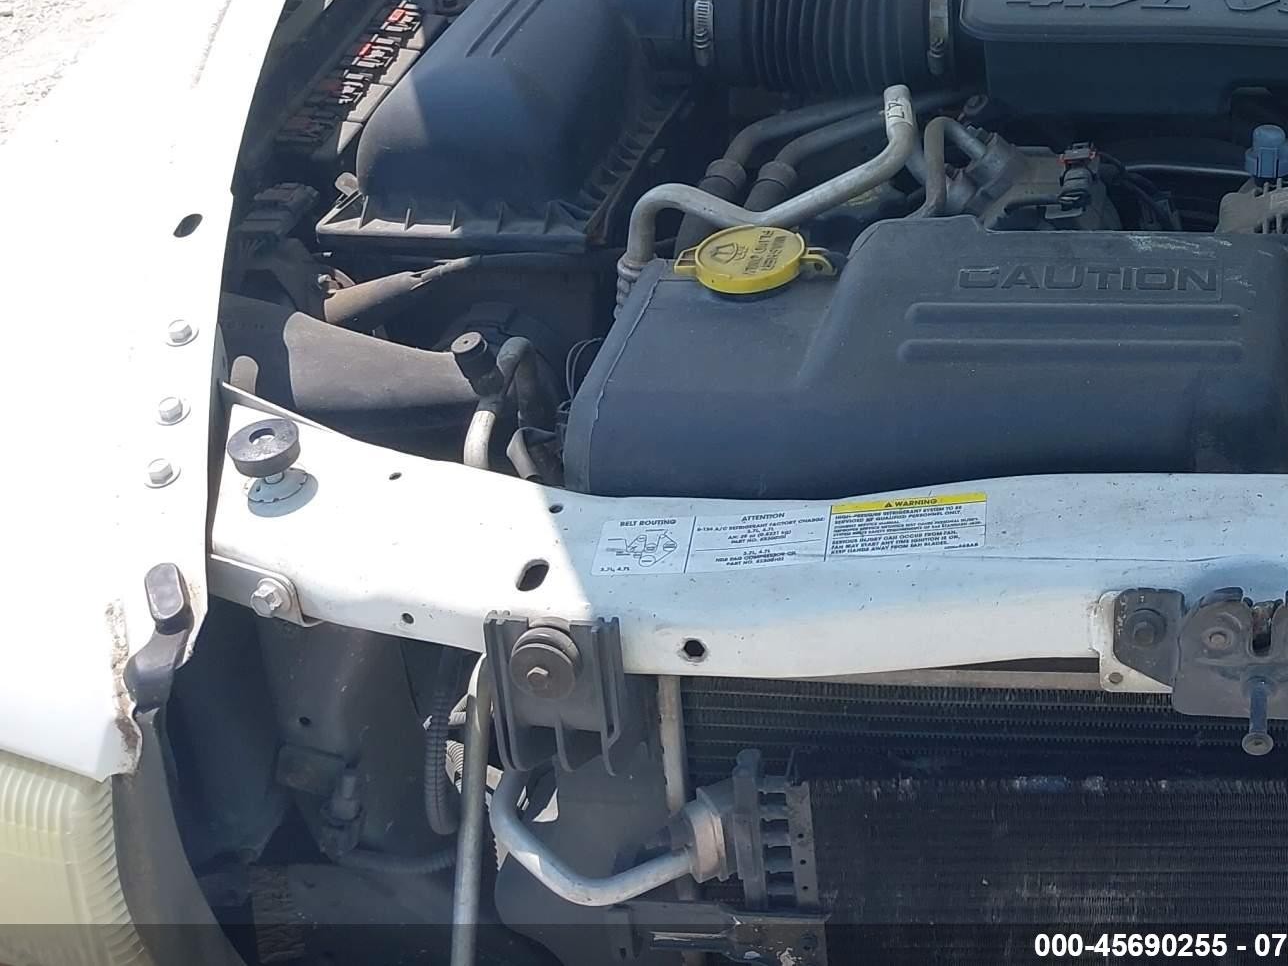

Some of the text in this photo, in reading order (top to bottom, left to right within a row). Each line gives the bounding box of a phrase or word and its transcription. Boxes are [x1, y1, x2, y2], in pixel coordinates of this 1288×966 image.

[957, 265, 1218, 292] CAUTION
[895, 498, 938, 507] WARNING
[741, 512, 785, 522] ATTENTION
